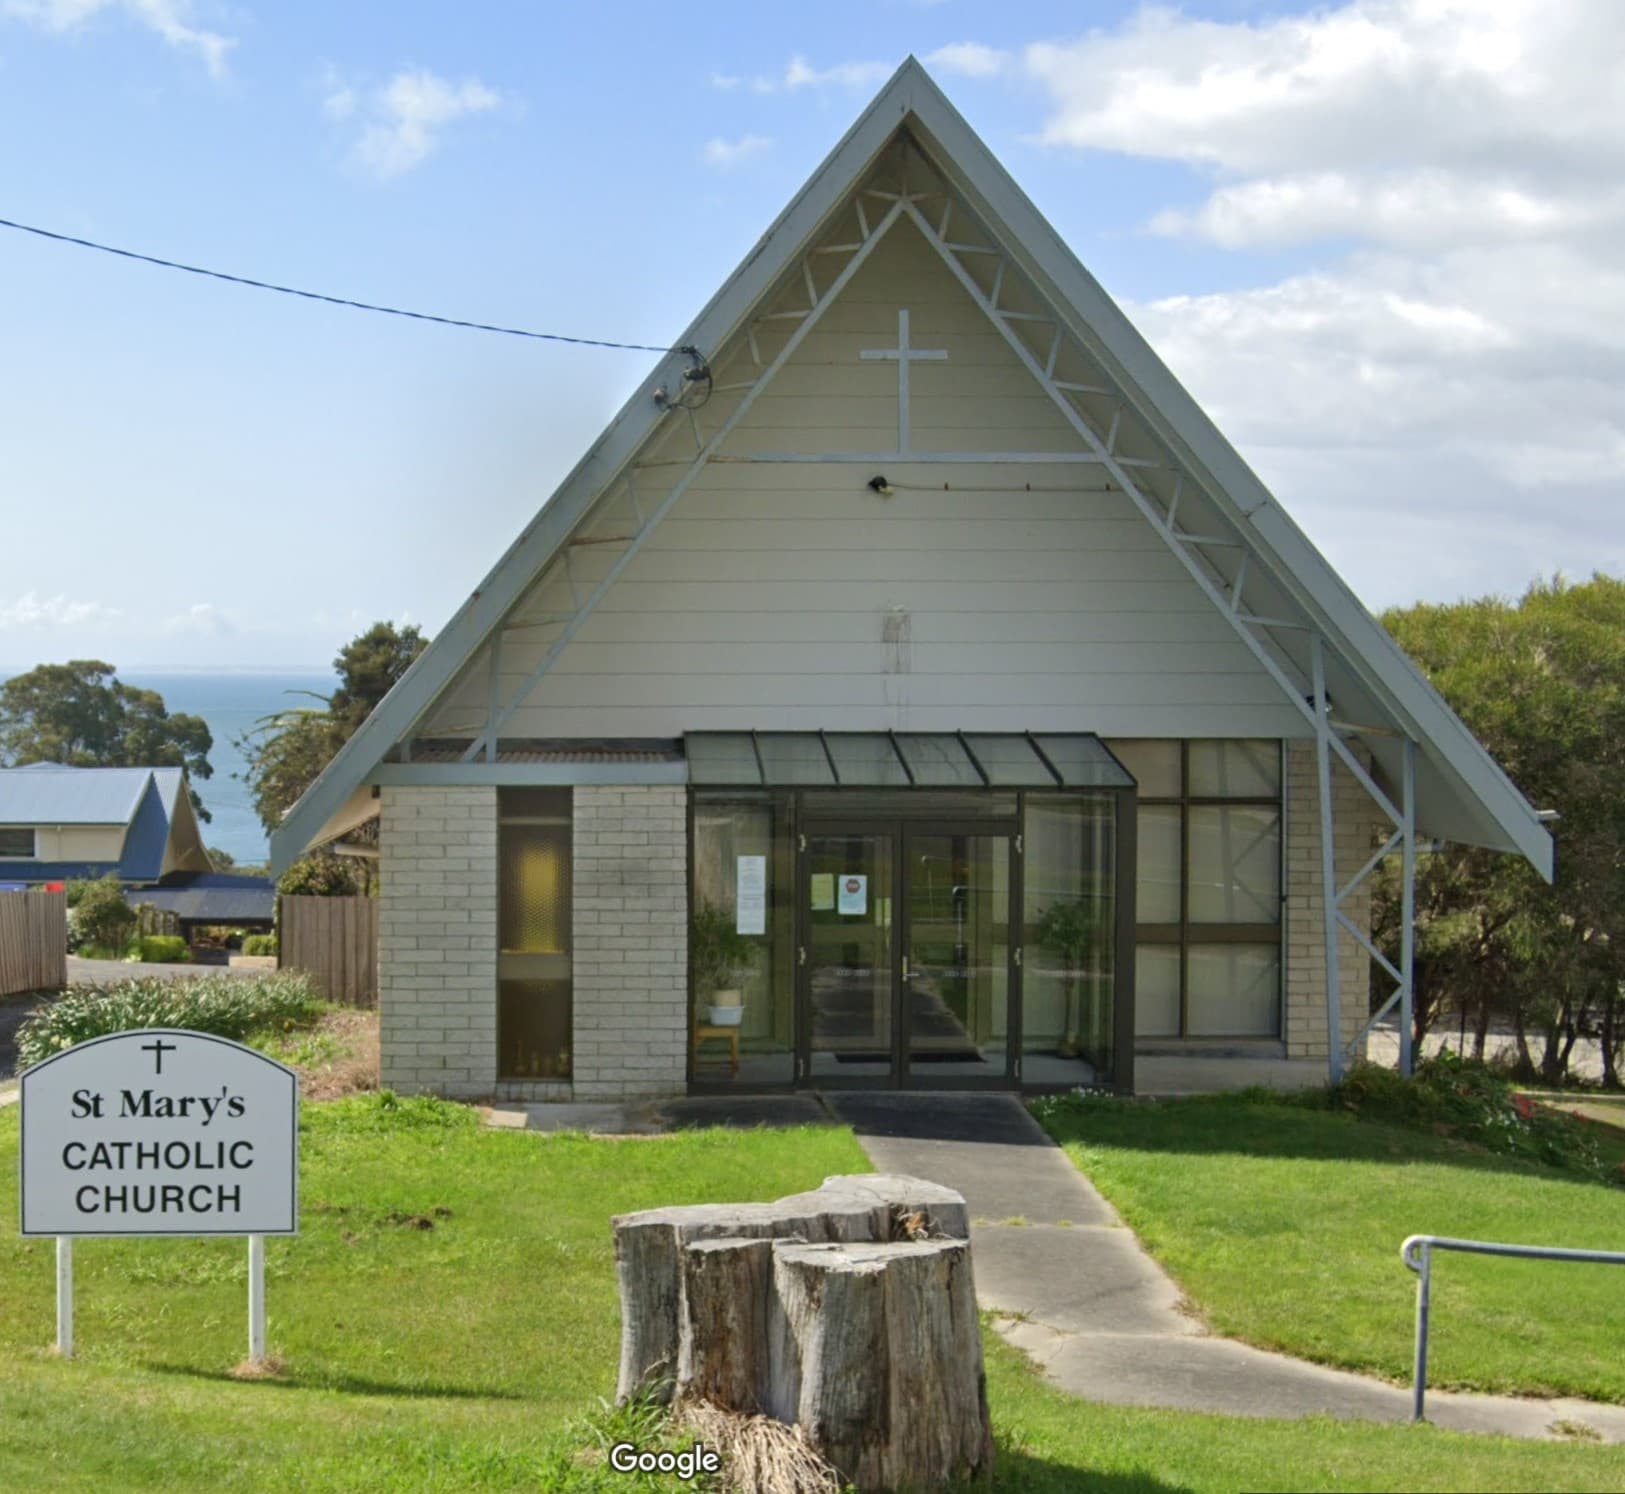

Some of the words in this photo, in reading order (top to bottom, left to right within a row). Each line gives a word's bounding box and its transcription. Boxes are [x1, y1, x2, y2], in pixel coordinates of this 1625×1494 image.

[71, 1089, 104, 1119] St
[119, 1086, 246, 1127] Mary's
[62, 1140, 255, 1170] CATHOLIC
[75, 1184, 241, 1214] CHURCH
